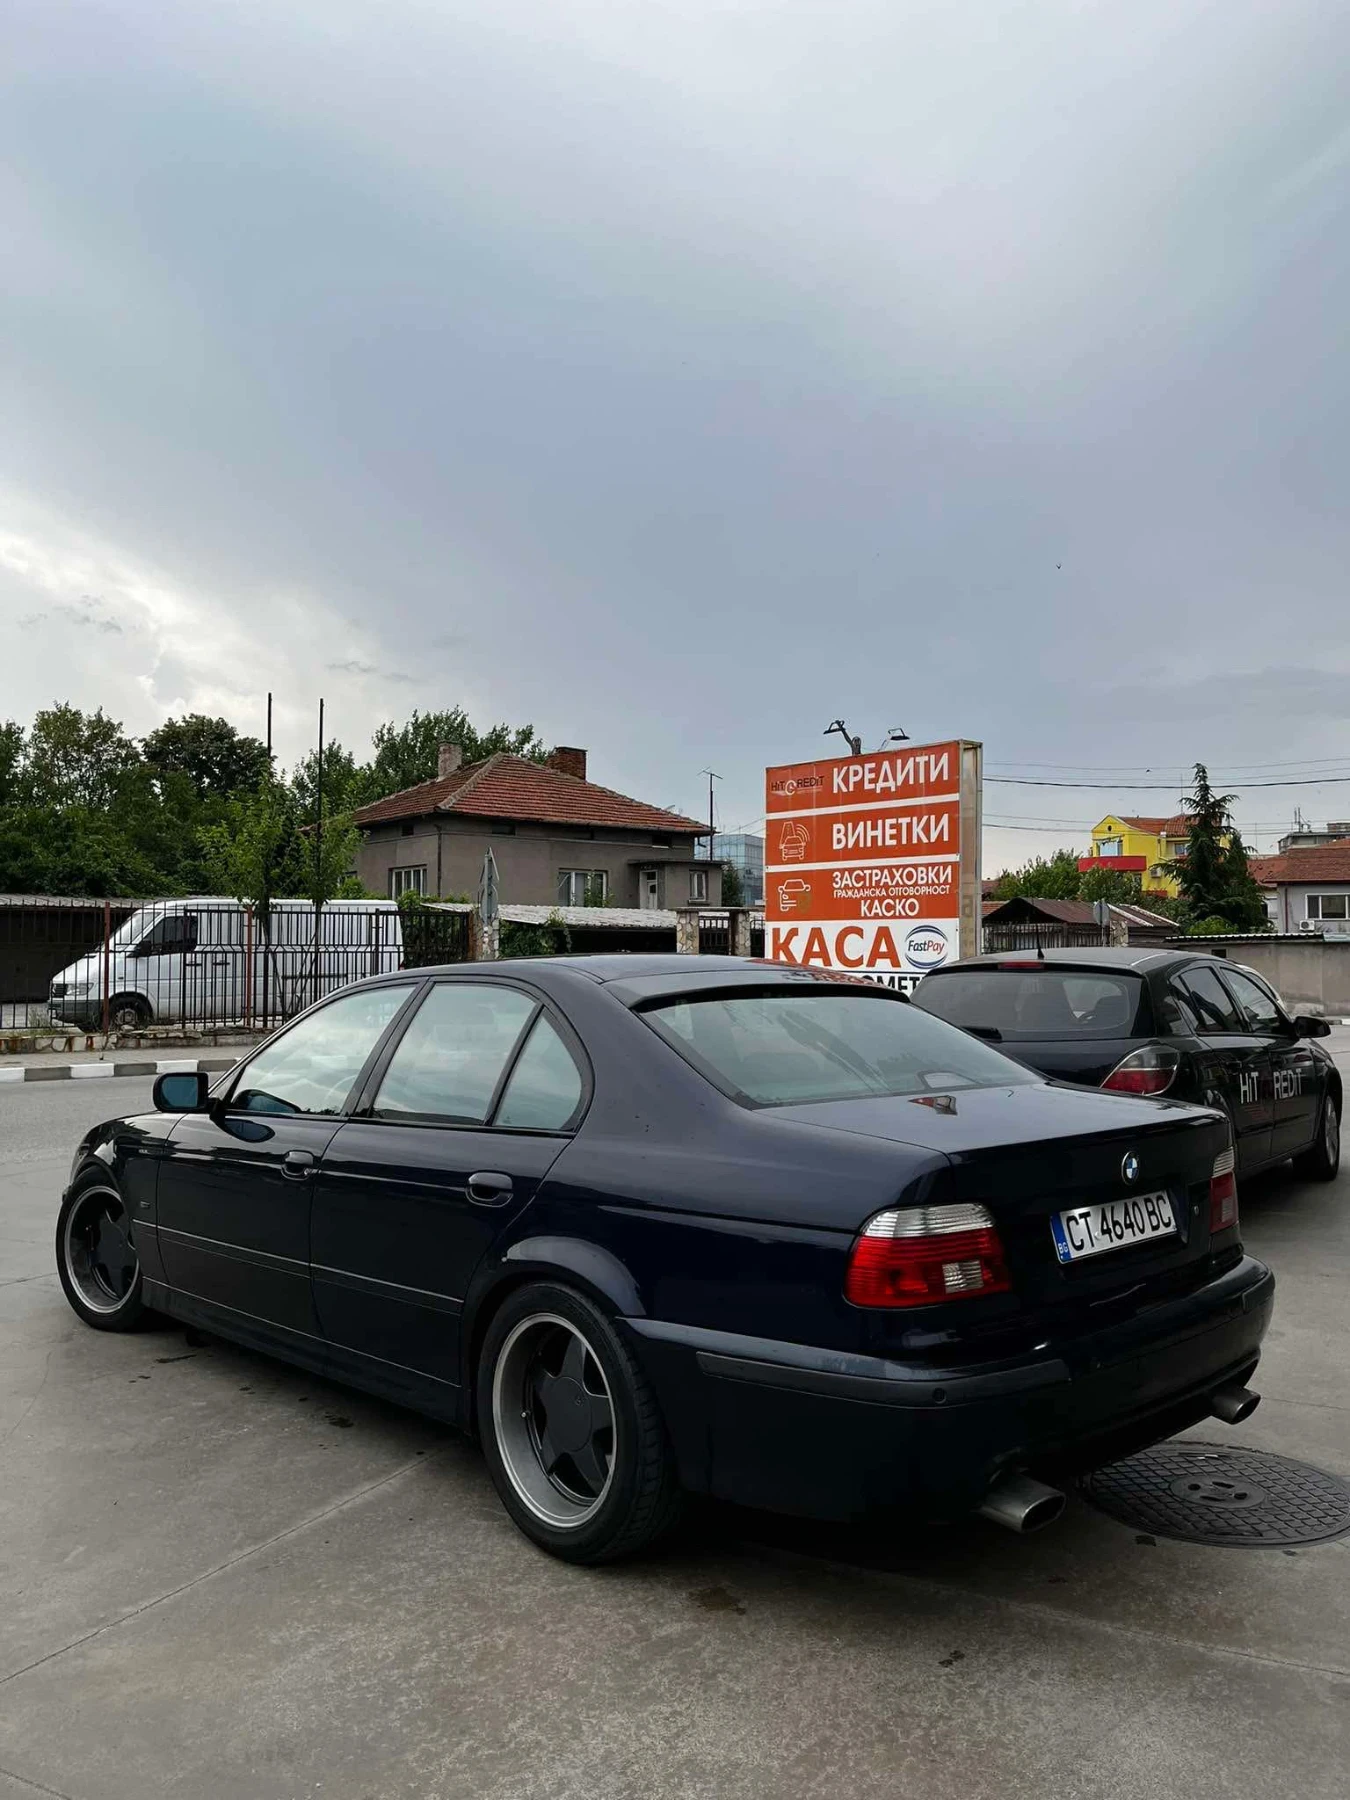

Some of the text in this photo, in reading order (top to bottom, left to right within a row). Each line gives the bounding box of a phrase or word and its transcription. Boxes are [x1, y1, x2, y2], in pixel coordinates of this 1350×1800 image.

[832, 752, 949, 794] КРЕДИТИ
[832, 813, 949, 850] ВИНЕТКИ
[832, 865, 952, 889] ЗАСТРАХОВКИ
[834, 885, 950, 898] ГРАЖДАНСКА ОТГОВОРНОСТ
[861, 898, 920, 917] КАСКО
[772, 925, 902, 968] КАСА
[908, 939, 945, 955] FastPay
[1066, 1194, 1172, 1252] CT 4640 BC
[1058, 1241, 1069, 1253] BG
